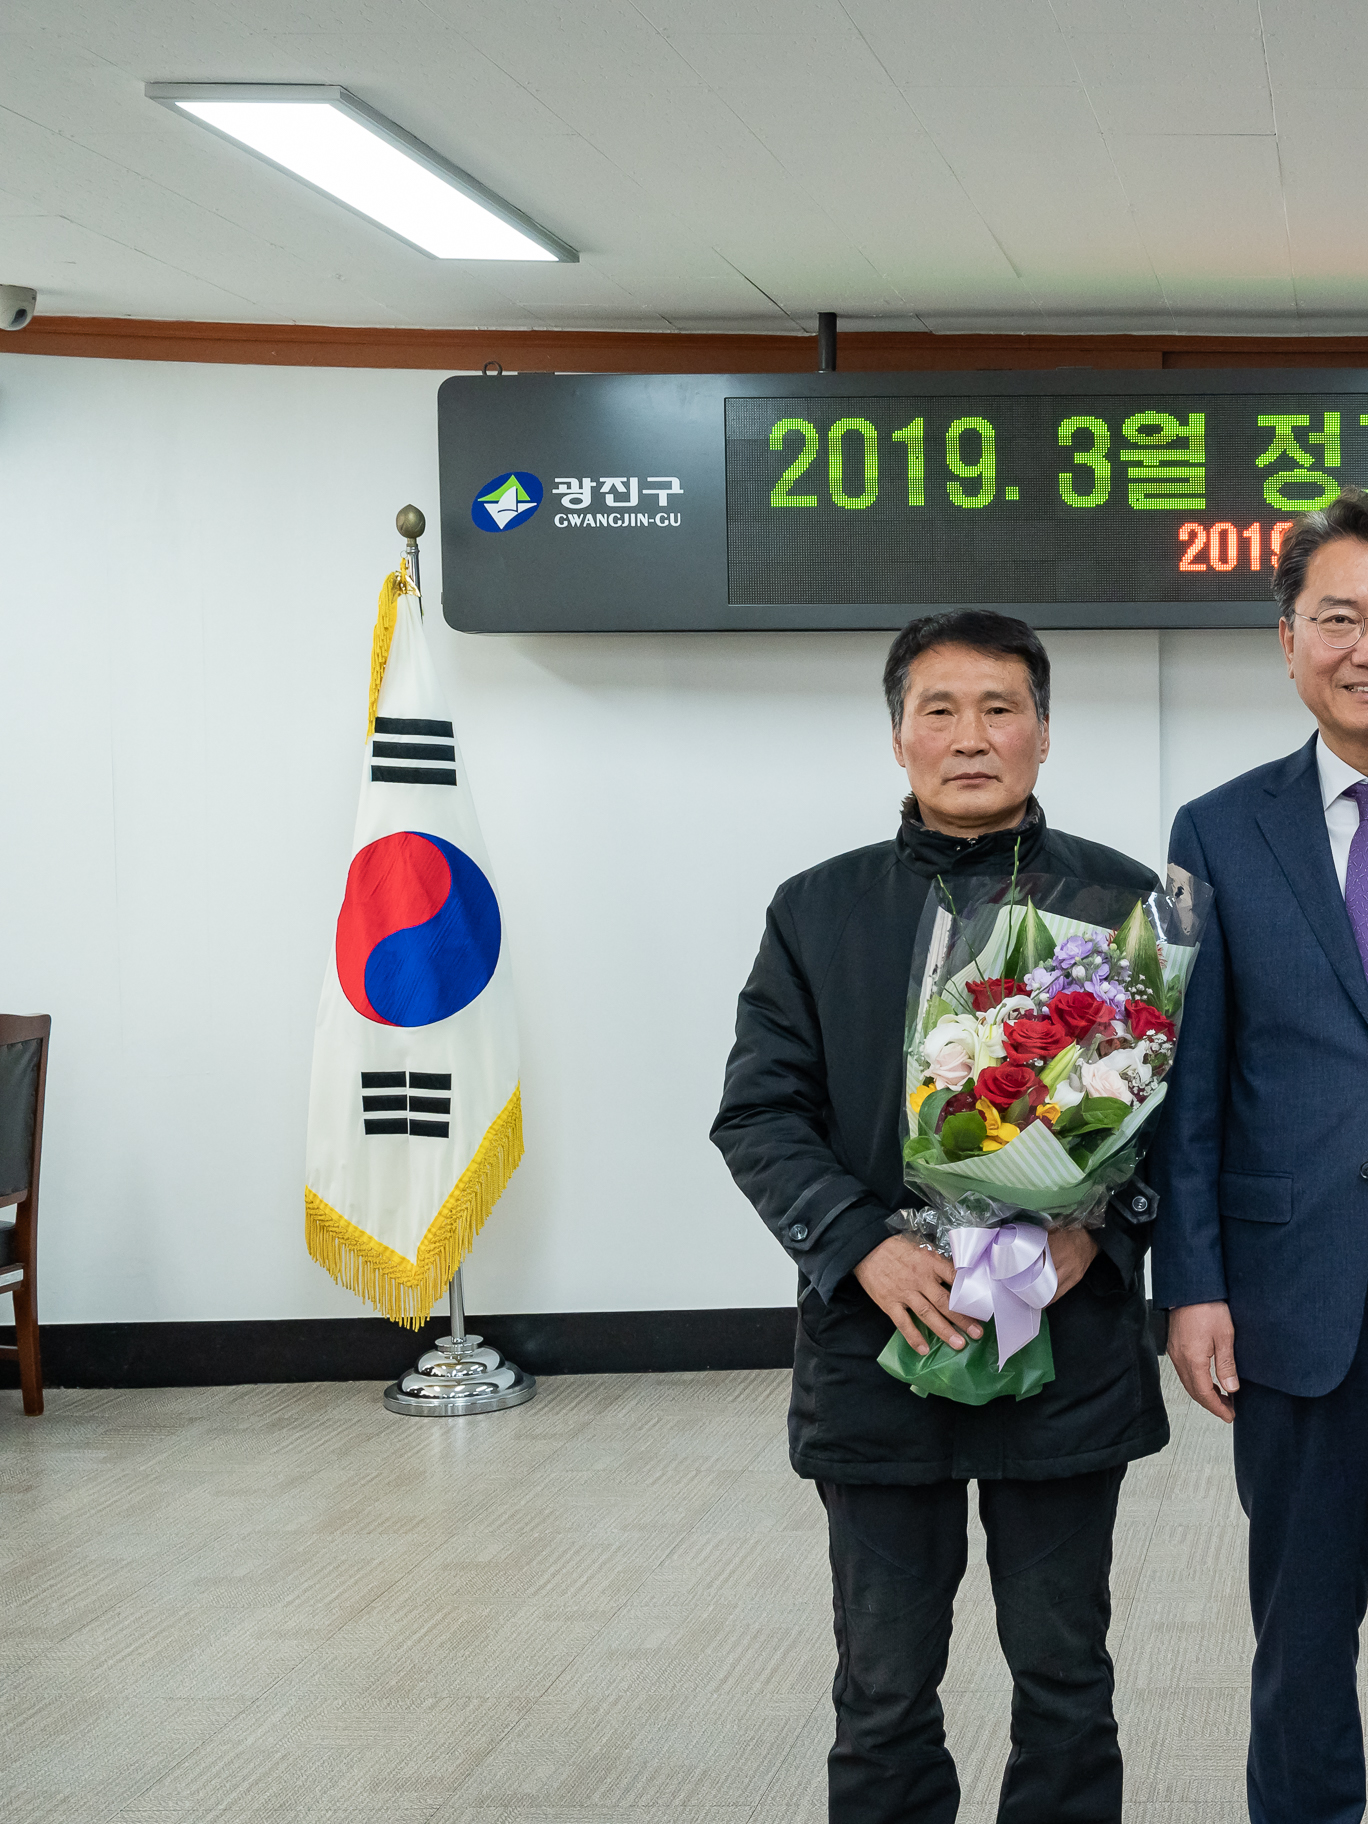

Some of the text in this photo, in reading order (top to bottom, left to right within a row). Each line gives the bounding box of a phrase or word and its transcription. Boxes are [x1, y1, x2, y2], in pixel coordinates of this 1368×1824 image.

[769, 416, 1020, 510] 2019.
[1058, 410, 1206, 510] 3월
[552, 477, 684, 509] 광진구
[554, 513, 681, 528] GWANGJIN-GU
